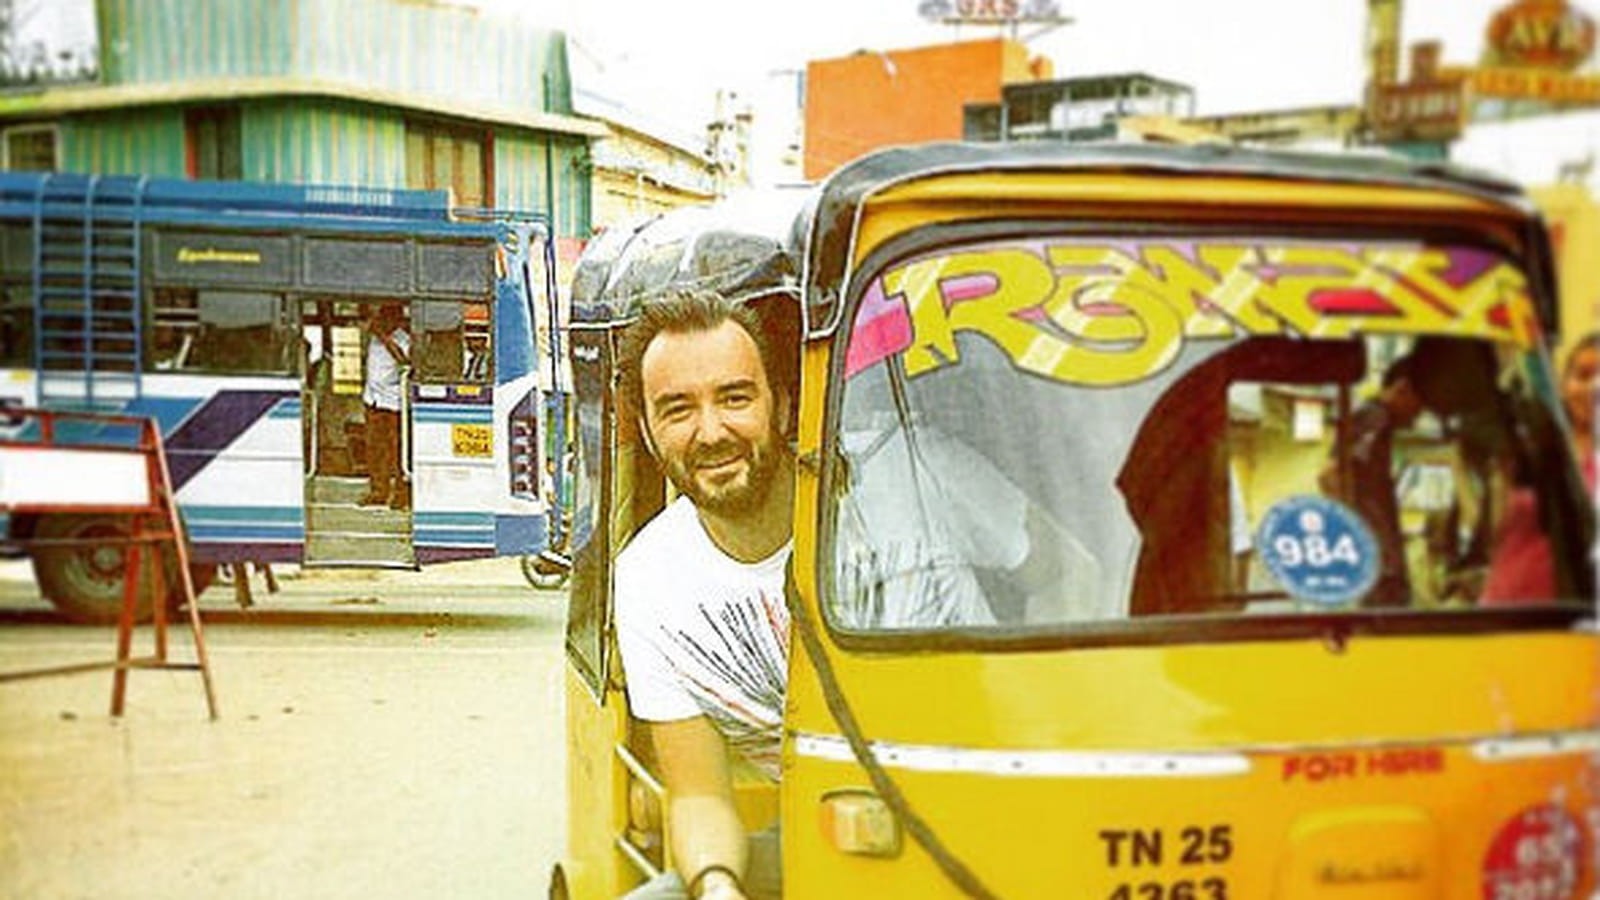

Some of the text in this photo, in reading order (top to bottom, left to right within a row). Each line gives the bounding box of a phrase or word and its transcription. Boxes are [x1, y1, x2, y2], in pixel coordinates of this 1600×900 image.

[1275, 534, 1358, 567] 984
[1282, 752, 1357, 782] FOR
[1098, 824, 1233, 867] TN 25
